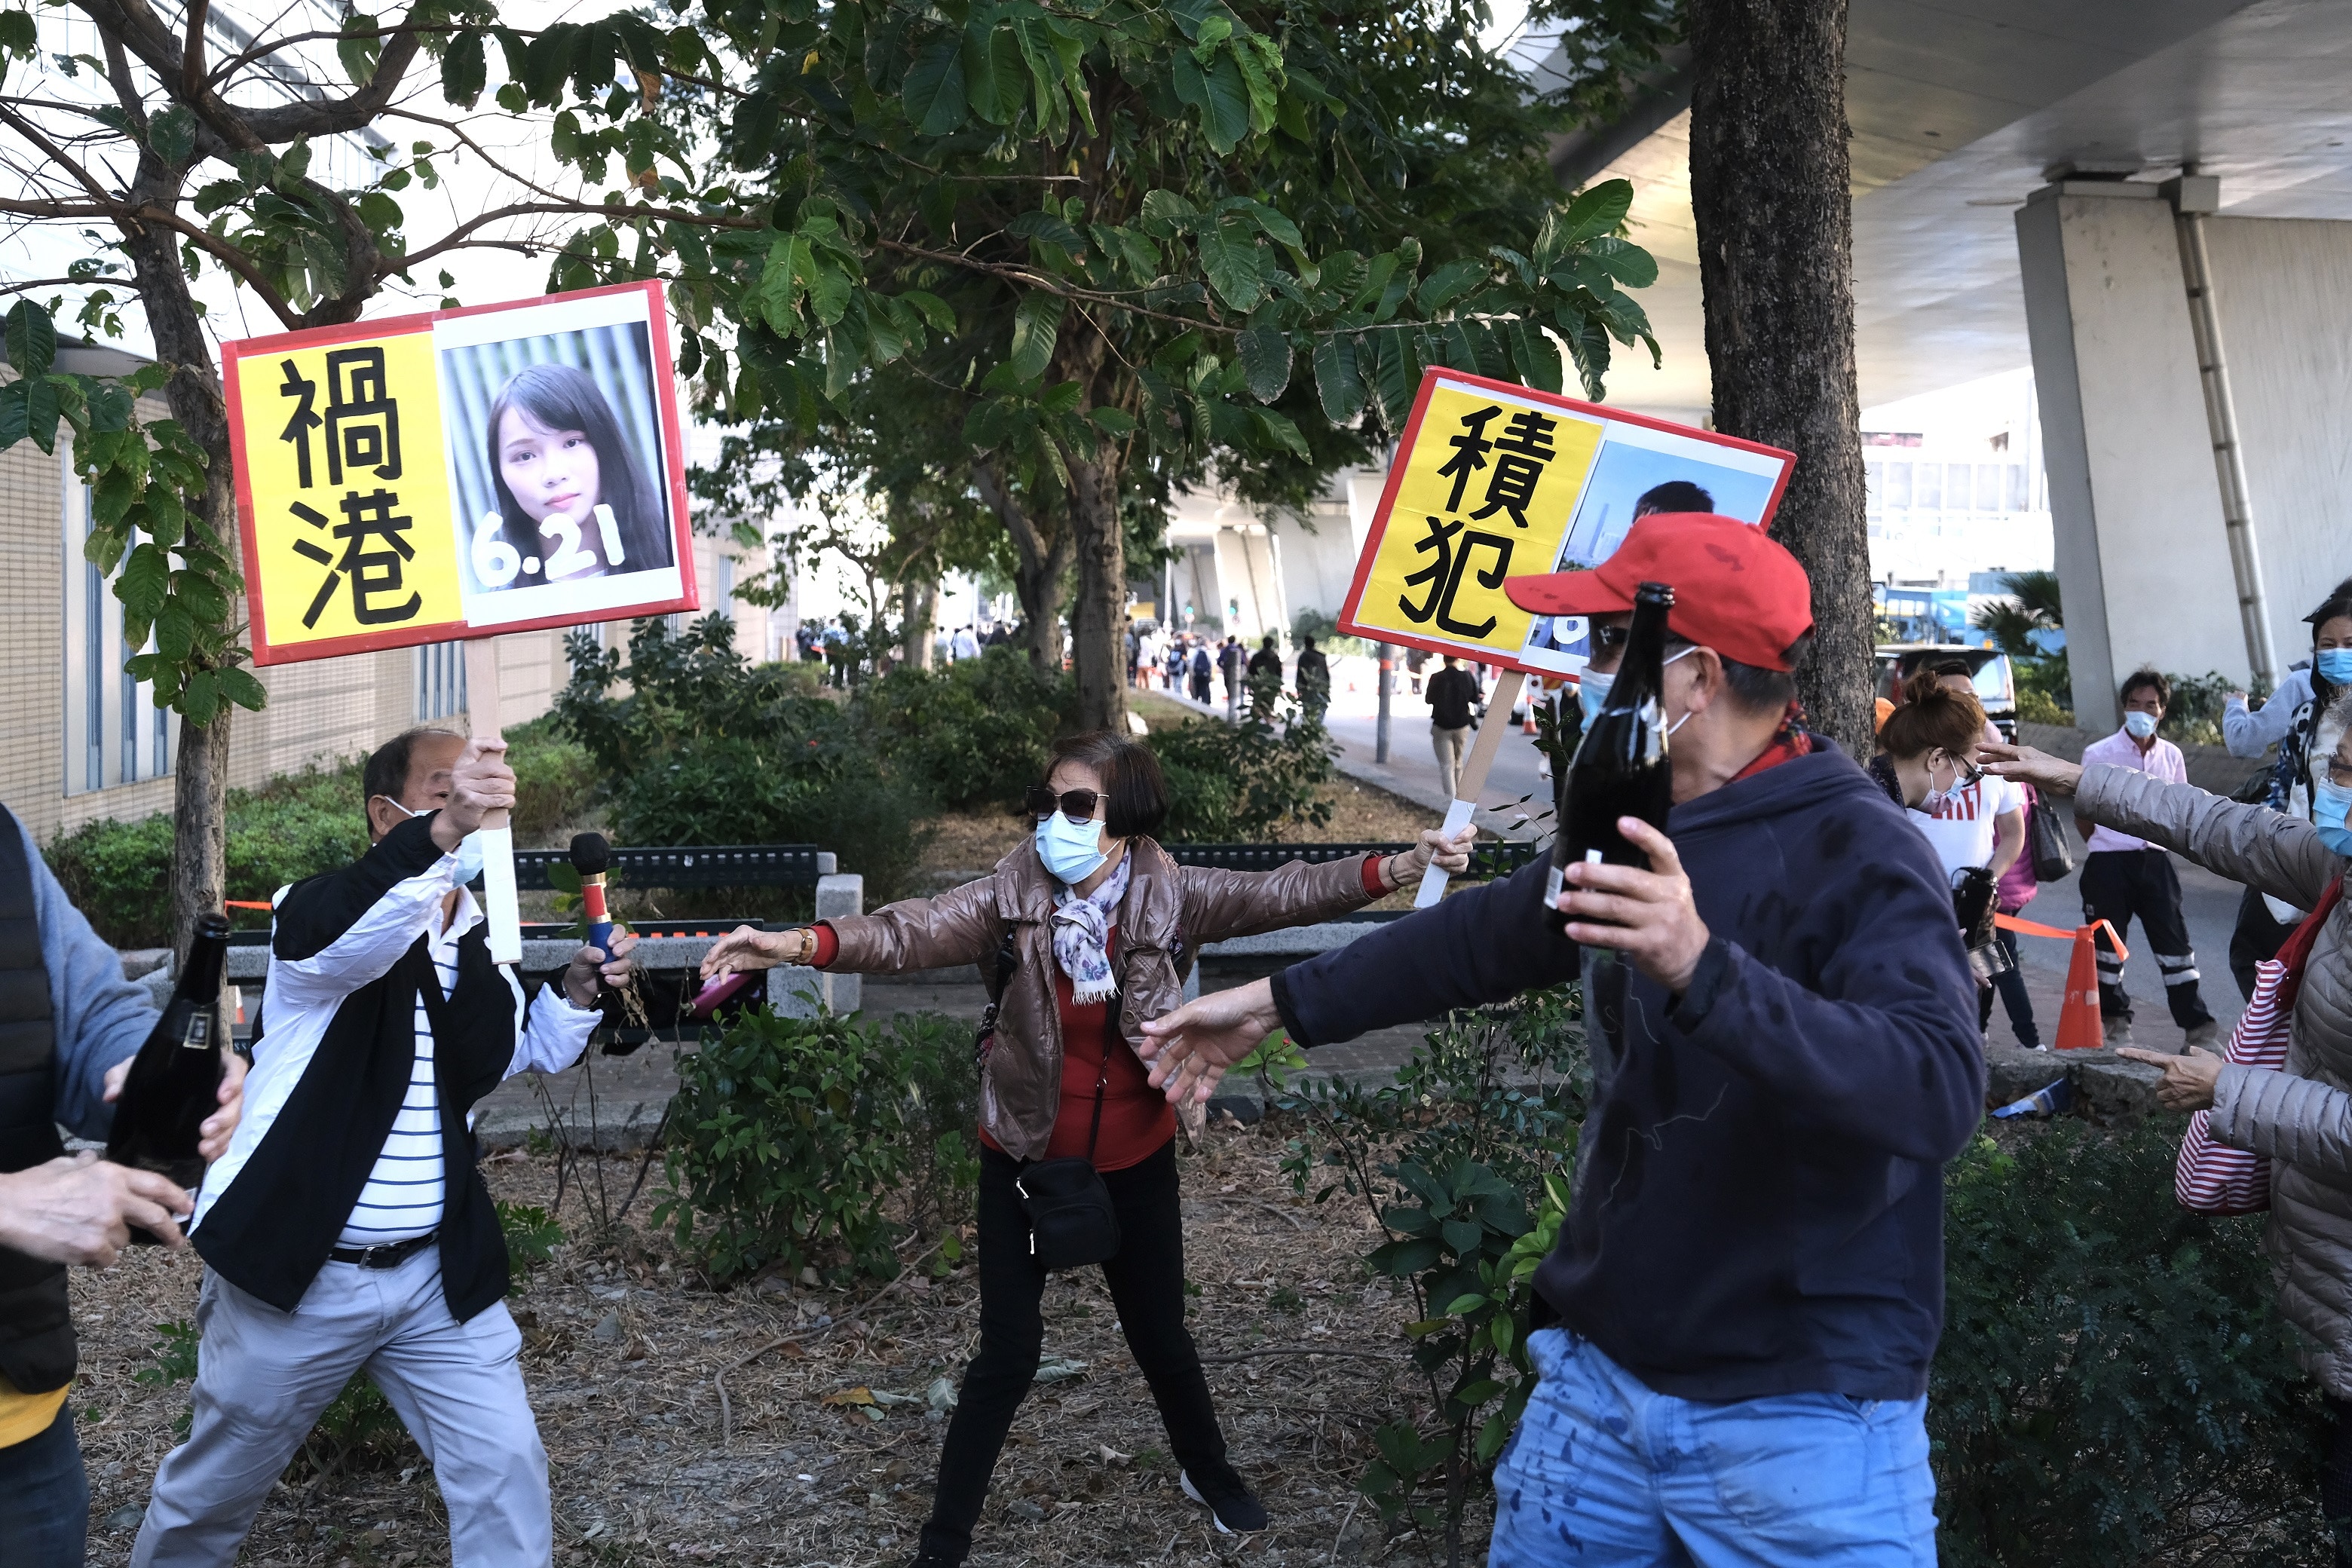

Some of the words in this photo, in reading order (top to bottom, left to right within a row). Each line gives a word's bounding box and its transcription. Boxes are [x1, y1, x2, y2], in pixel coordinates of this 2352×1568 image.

[280, 347, 421, 629] 禍港
[471, 504, 625, 588] 6.21
[1399, 406, 1556, 638] 積犯
